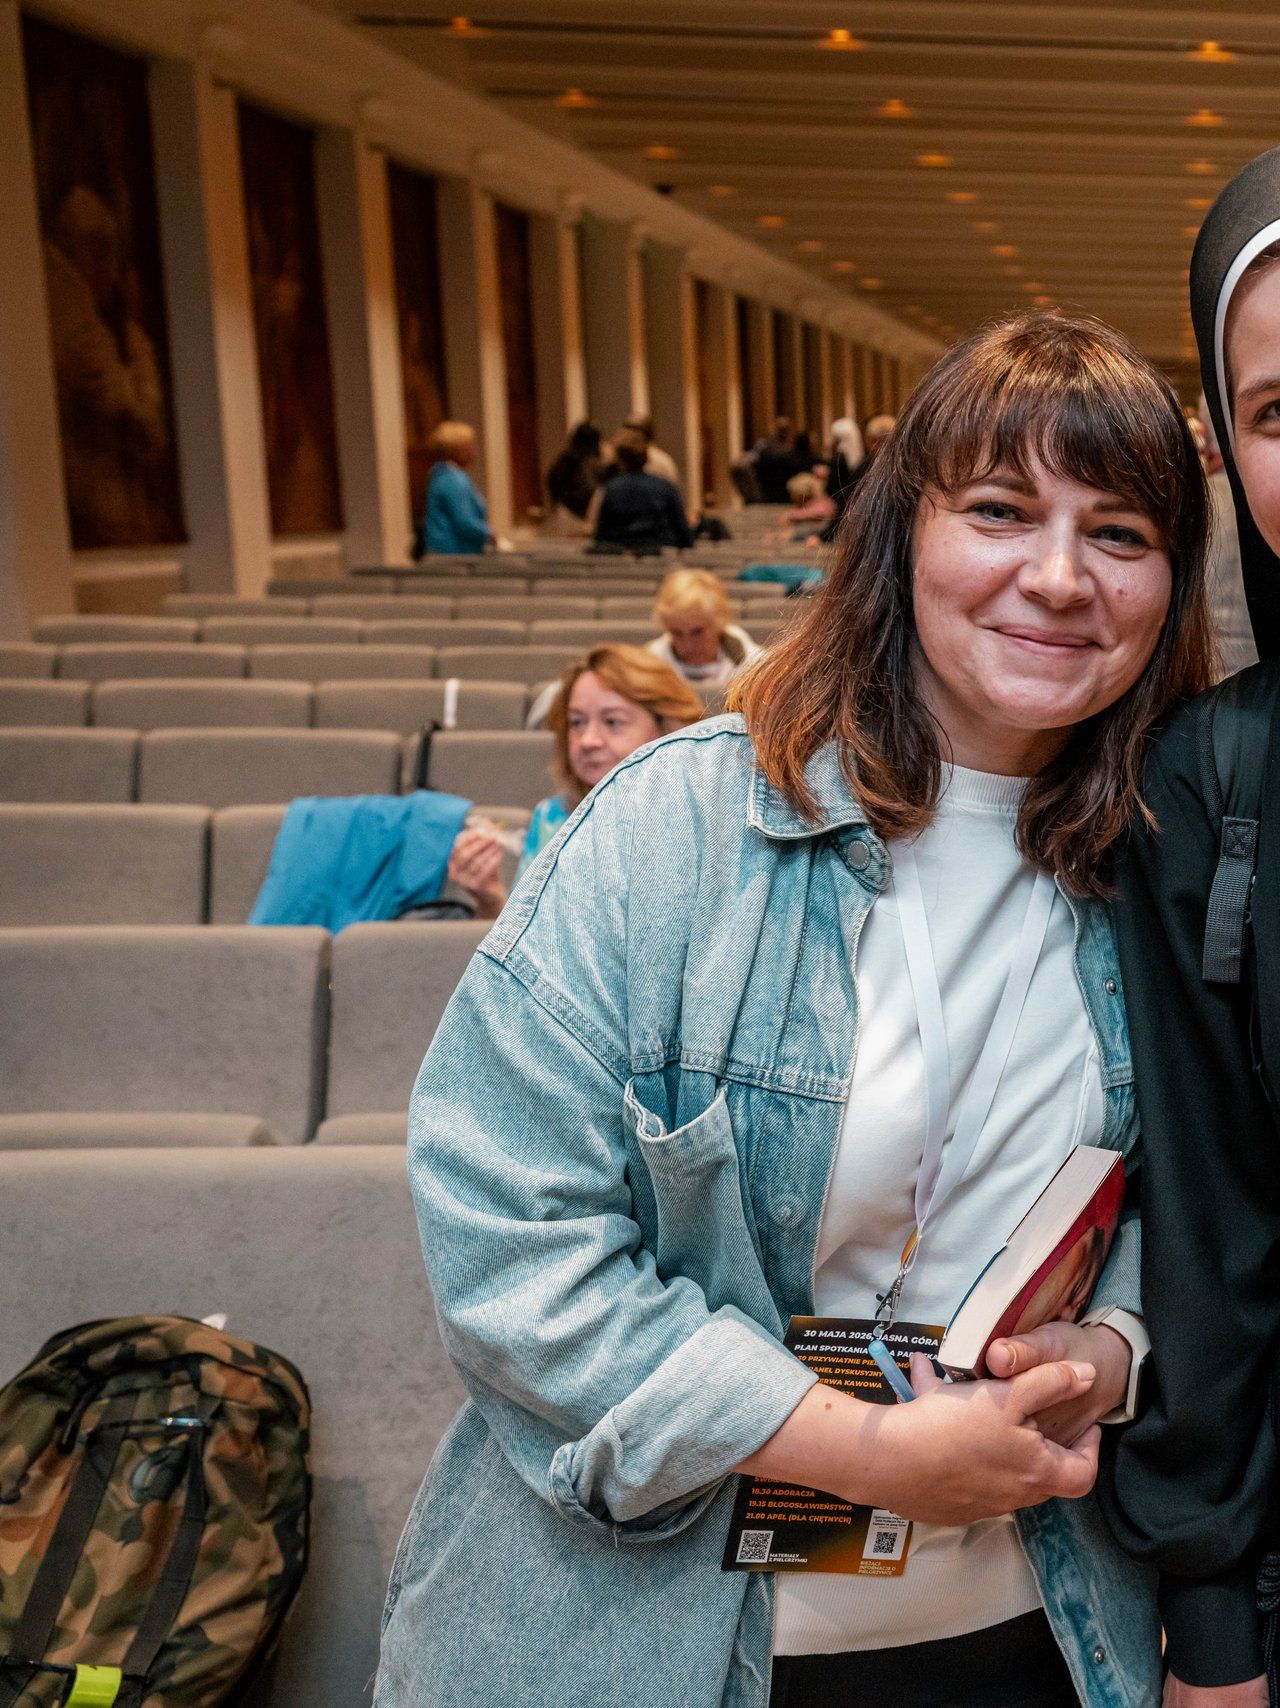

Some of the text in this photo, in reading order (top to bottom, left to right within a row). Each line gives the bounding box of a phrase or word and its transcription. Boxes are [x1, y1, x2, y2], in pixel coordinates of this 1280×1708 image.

[803, 1329, 939, 1346] 30 MAJA 2026, JASNA GÓRA
[794, 1344, 818, 1352] PLAN
[819, 1345, 869, 1354] SPOTKANIA
[834, 1368, 884, 1377] DYSKUSYJNY
[844, 1380, 883, 1389] KAWOWA
[772, 1489, 815, 1497] ADORACJA
[748, 1500, 853, 1511] 19.15 BŁOGOSŁAWIEŃSTWO
[788, 1513, 807, 1522] (DLA
[808, 1515, 852, 1525] CHĘTNYCH)
